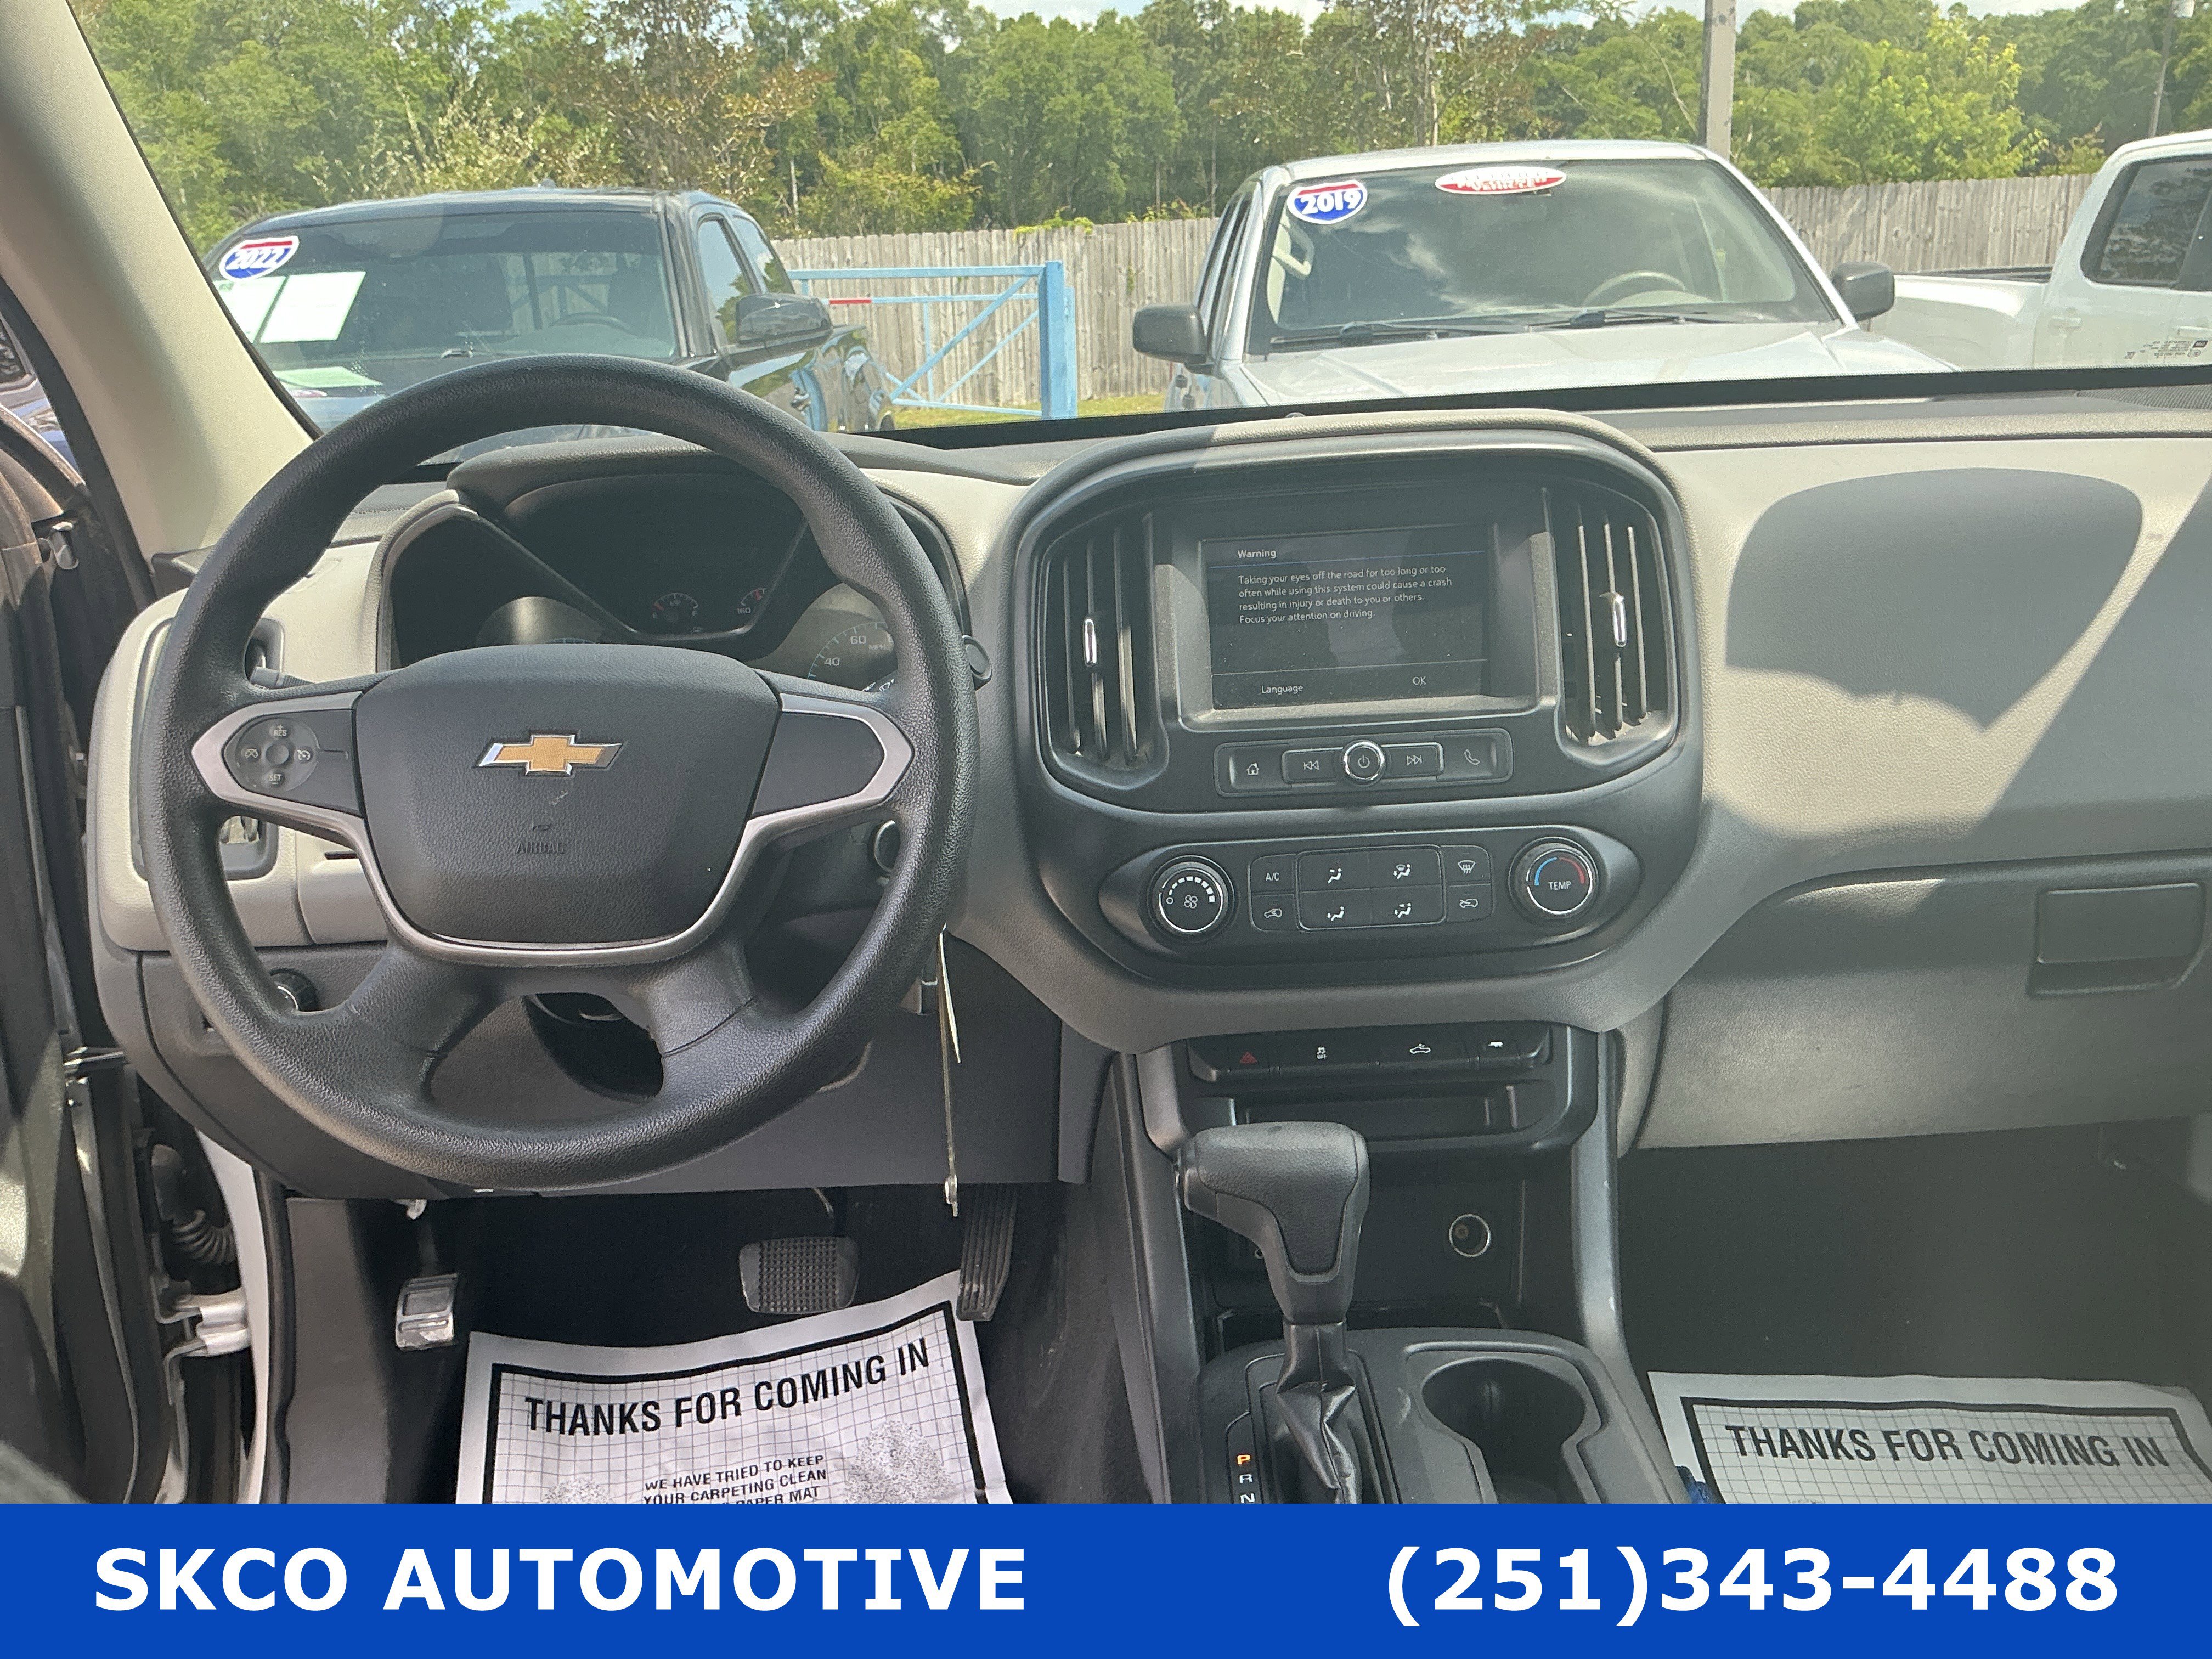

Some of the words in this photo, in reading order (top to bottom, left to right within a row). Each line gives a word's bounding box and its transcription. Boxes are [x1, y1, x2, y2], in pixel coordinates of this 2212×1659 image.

[1300, 190, 1361, 215] 2019
[225, 248, 286, 270] 2022
[1237, 549, 1277, 559] Warning
[1238, 575, 1267, 585] Taking
[1269, 575, 1288, 585] your
[1290, 574, 1310, 583] eyes
[1312, 571, 1325, 580] off
[1327, 570, 1341, 579] the
[1344, 569, 1363, 578] road
[1365, 568, 1378, 577] for
[1397, 567, 1417, 577] long
[1239, 588, 1262, 597] often
[1264, 587, 1286, 596] while
[1289, 586, 1312, 596] using
[1314, 583, 1331, 594] this
[1333, 583, 1364, 594] system
[1367, 581, 1390, 590] could
[1392, 580, 1418, 589] cause
[1428, 577, 1452, 586] crash
[1239, 601, 1277, 612] resulting
[1279, 600, 1287, 608] in
[1289, 600, 1313, 611] injury
[1327, 596, 1351, 606] death
[1364, 596, 1380, 606] you
[1394, 593, 1425, 602] others.
[1239, 615, 1265, 624] Focus
[1267, 615, 1286, 624] your
[1288, 611, 1328, 622] attention
[1343, 609, 1375, 619] driving.
[850, 635, 866, 645] 60
[825, 657, 840, 666] 40
[1413, 676, 1426, 686] OK
[1261, 685, 1304, 695] Language
[517, 842, 565, 854] AIRBAG
[1265, 872, 1280, 882] A/C
[1548, 881, 1571, 890] TEMP
[525, 1396, 661, 1436] THANKS
[675, 1387, 742, 1427] FOR
[754, 1355, 887, 1410] COMING
[898, 1338, 929, 1376] IN
[1725, 1425, 1876, 1462] THANKS
[1883, 1429, 1964, 1462] FOR
[1968, 1430, 2121, 1466] COMING
[2122, 1436, 2169, 1466] IN
[1237, 1454, 1251, 1465] P
[645, 1479, 668, 1491] WE
[673, 1472, 711, 1488] HAVE
[715, 1465, 758, 1483] TRIED
[764, 1459, 782, 1473] TO
[788, 1455, 823, 1469] KEEP
[1239, 1474, 1253, 1483] R
[644, 1493, 685, 1504] YOUR
[690, 1478, 775, 1502] CARPETING
[780, 1469, 827, 1487] CLEAN
[789, 1486, 821, 1503] MAT
[1240, 1493, 1255, 1504] N
